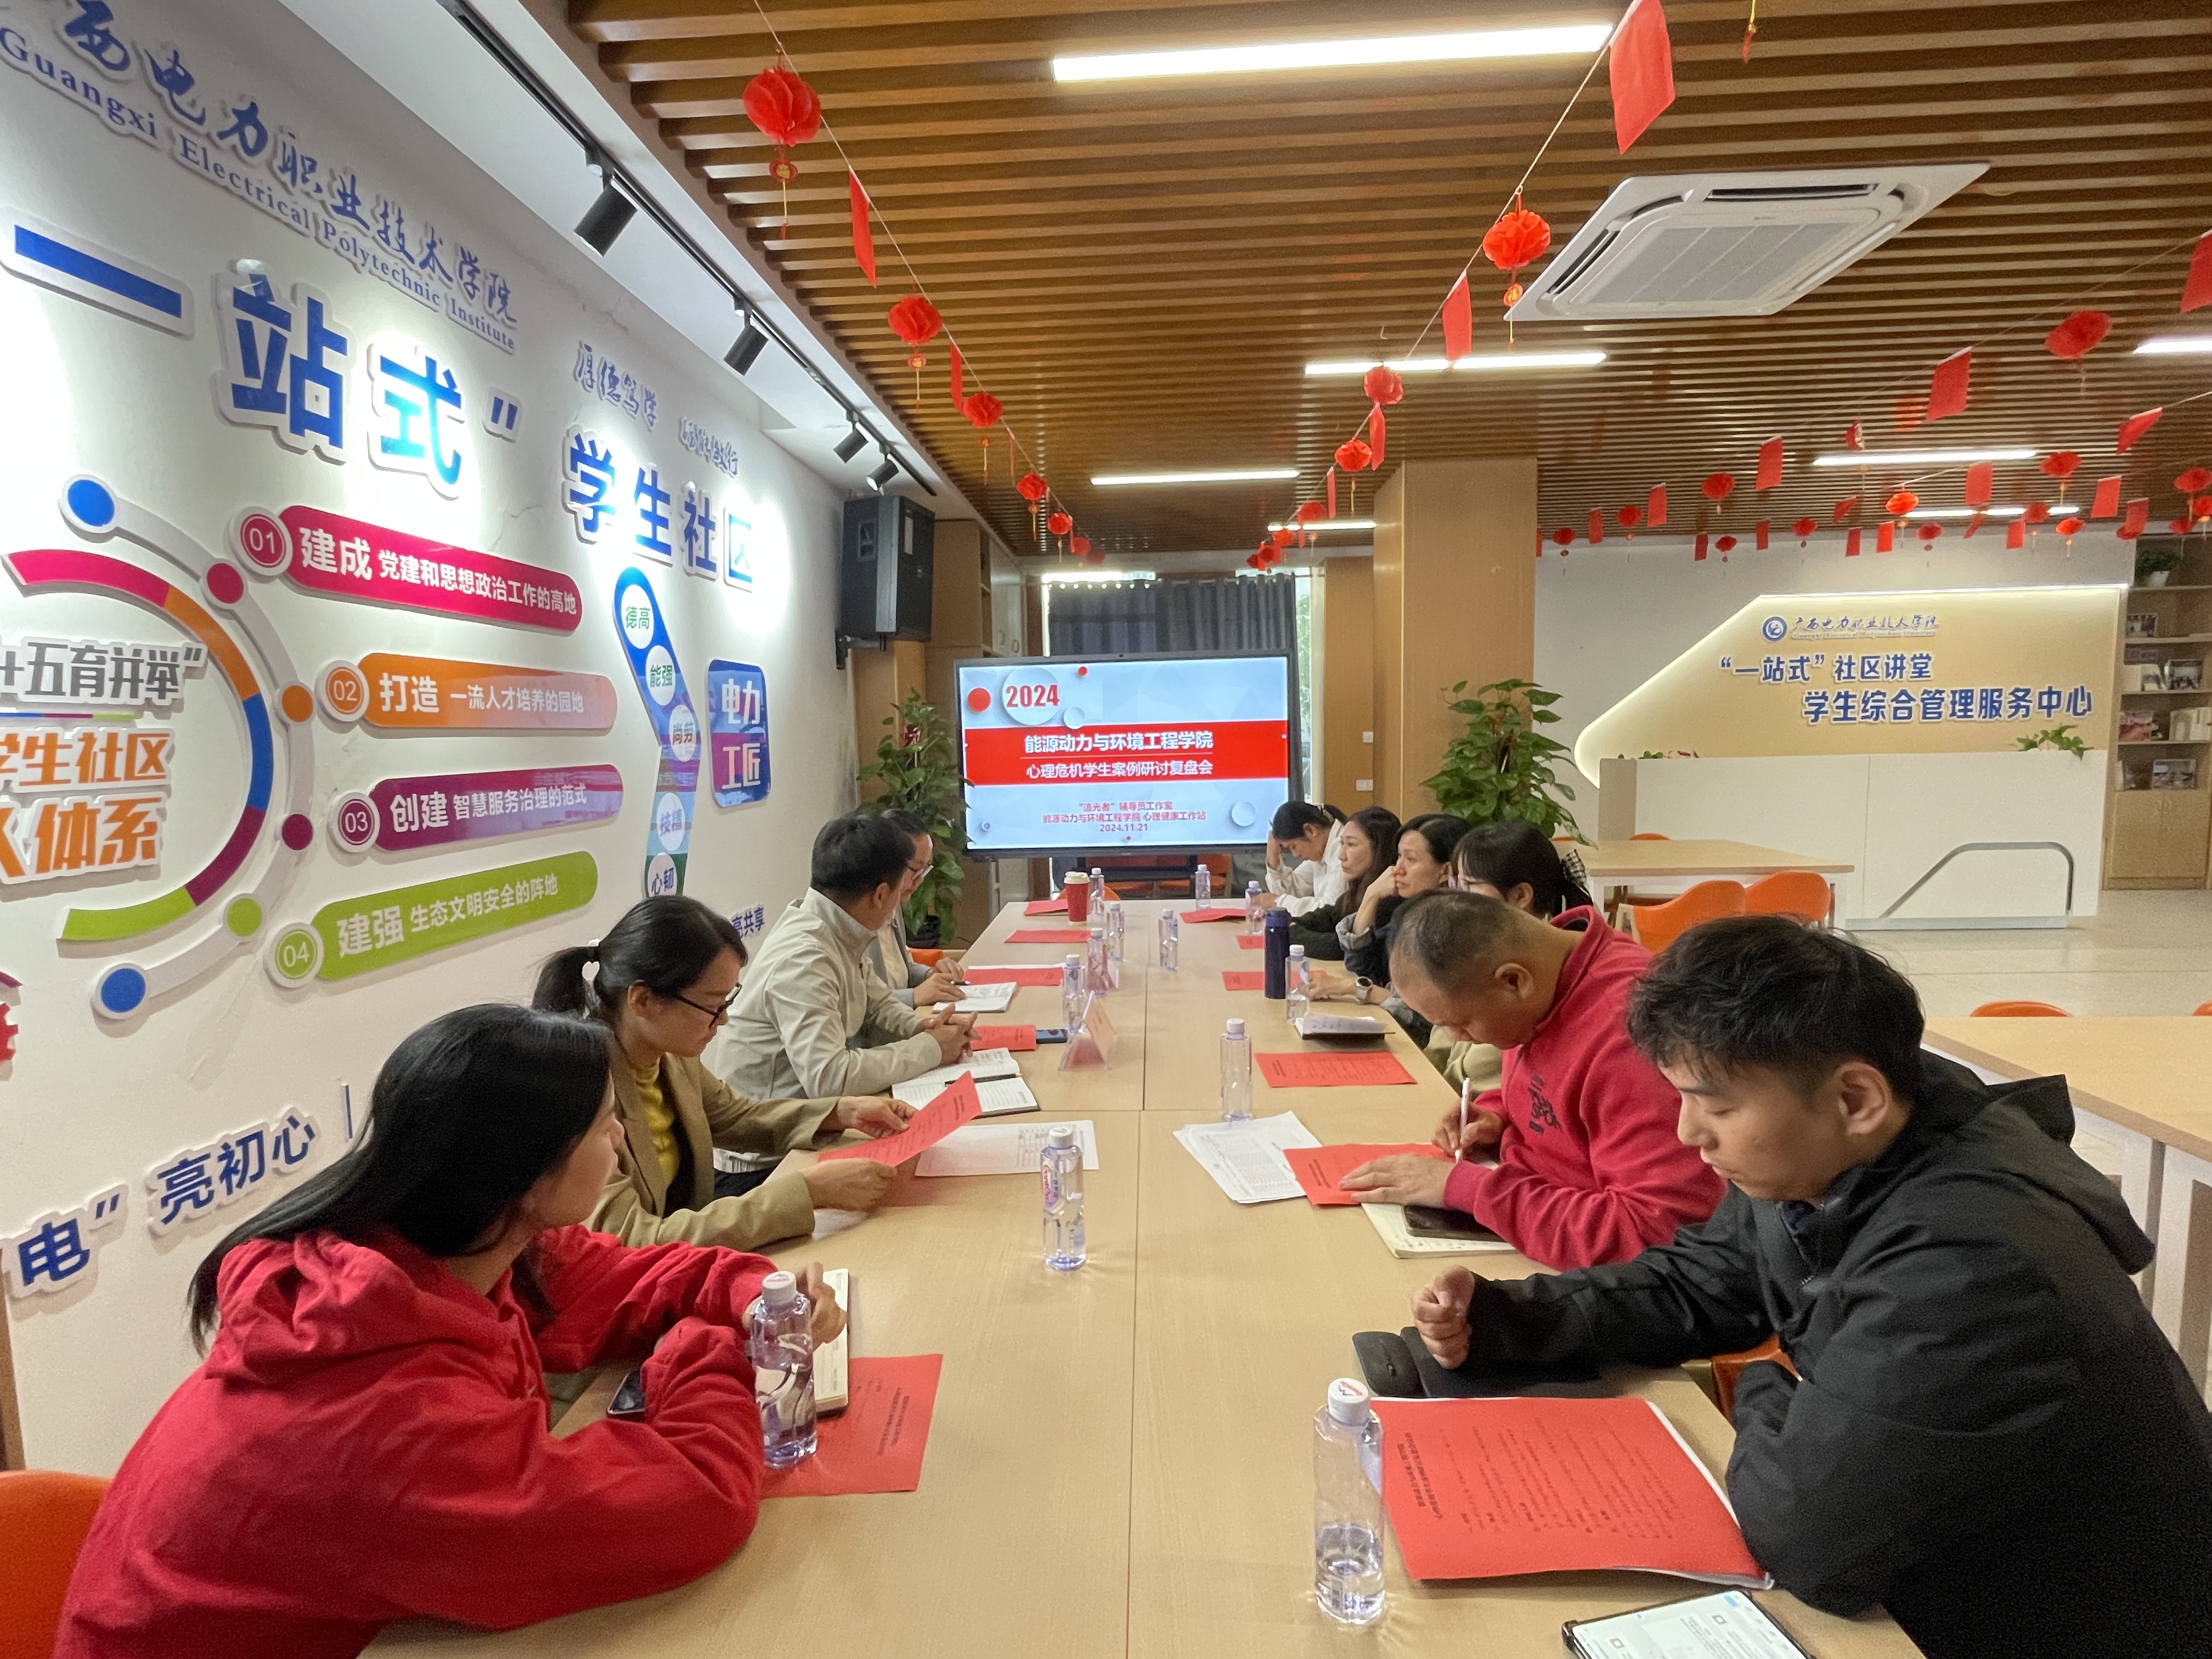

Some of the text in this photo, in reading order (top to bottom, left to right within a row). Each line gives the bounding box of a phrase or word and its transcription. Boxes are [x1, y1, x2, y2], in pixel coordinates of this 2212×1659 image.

[0, 27, 515, 350] Guangxi Electrical Polytechnic Institute
[250, 527, 577, 615] 01 建成 党建和思想政治工作的高地
[626, 606, 651, 630] 德高
[333, 674, 584, 714] 02 打造 一流人才培养的园地
[650, 665, 673, 688] 能强
[722, 678, 760, 725] 电力
[1005, 685, 1059, 708] 2024
[1804, 686, 2092, 724] 学生综合管理服务中心
[1024, 731, 1214, 754] 能源动力与环境工程学院
[722, 743, 761, 789] 工匠
[1026, 760, 1214, 779] 心理危机学生案例研讨复盘会
[344, 783, 587, 833] 03 创建 智慧服务治理的范式
[1043, 812, 1141, 823] 能源动力与环境工程学院
[1099, 823, 1148, 832] 2024.11.21
[283, 873, 558, 968] 04 建强 生态文明安全的阵地
